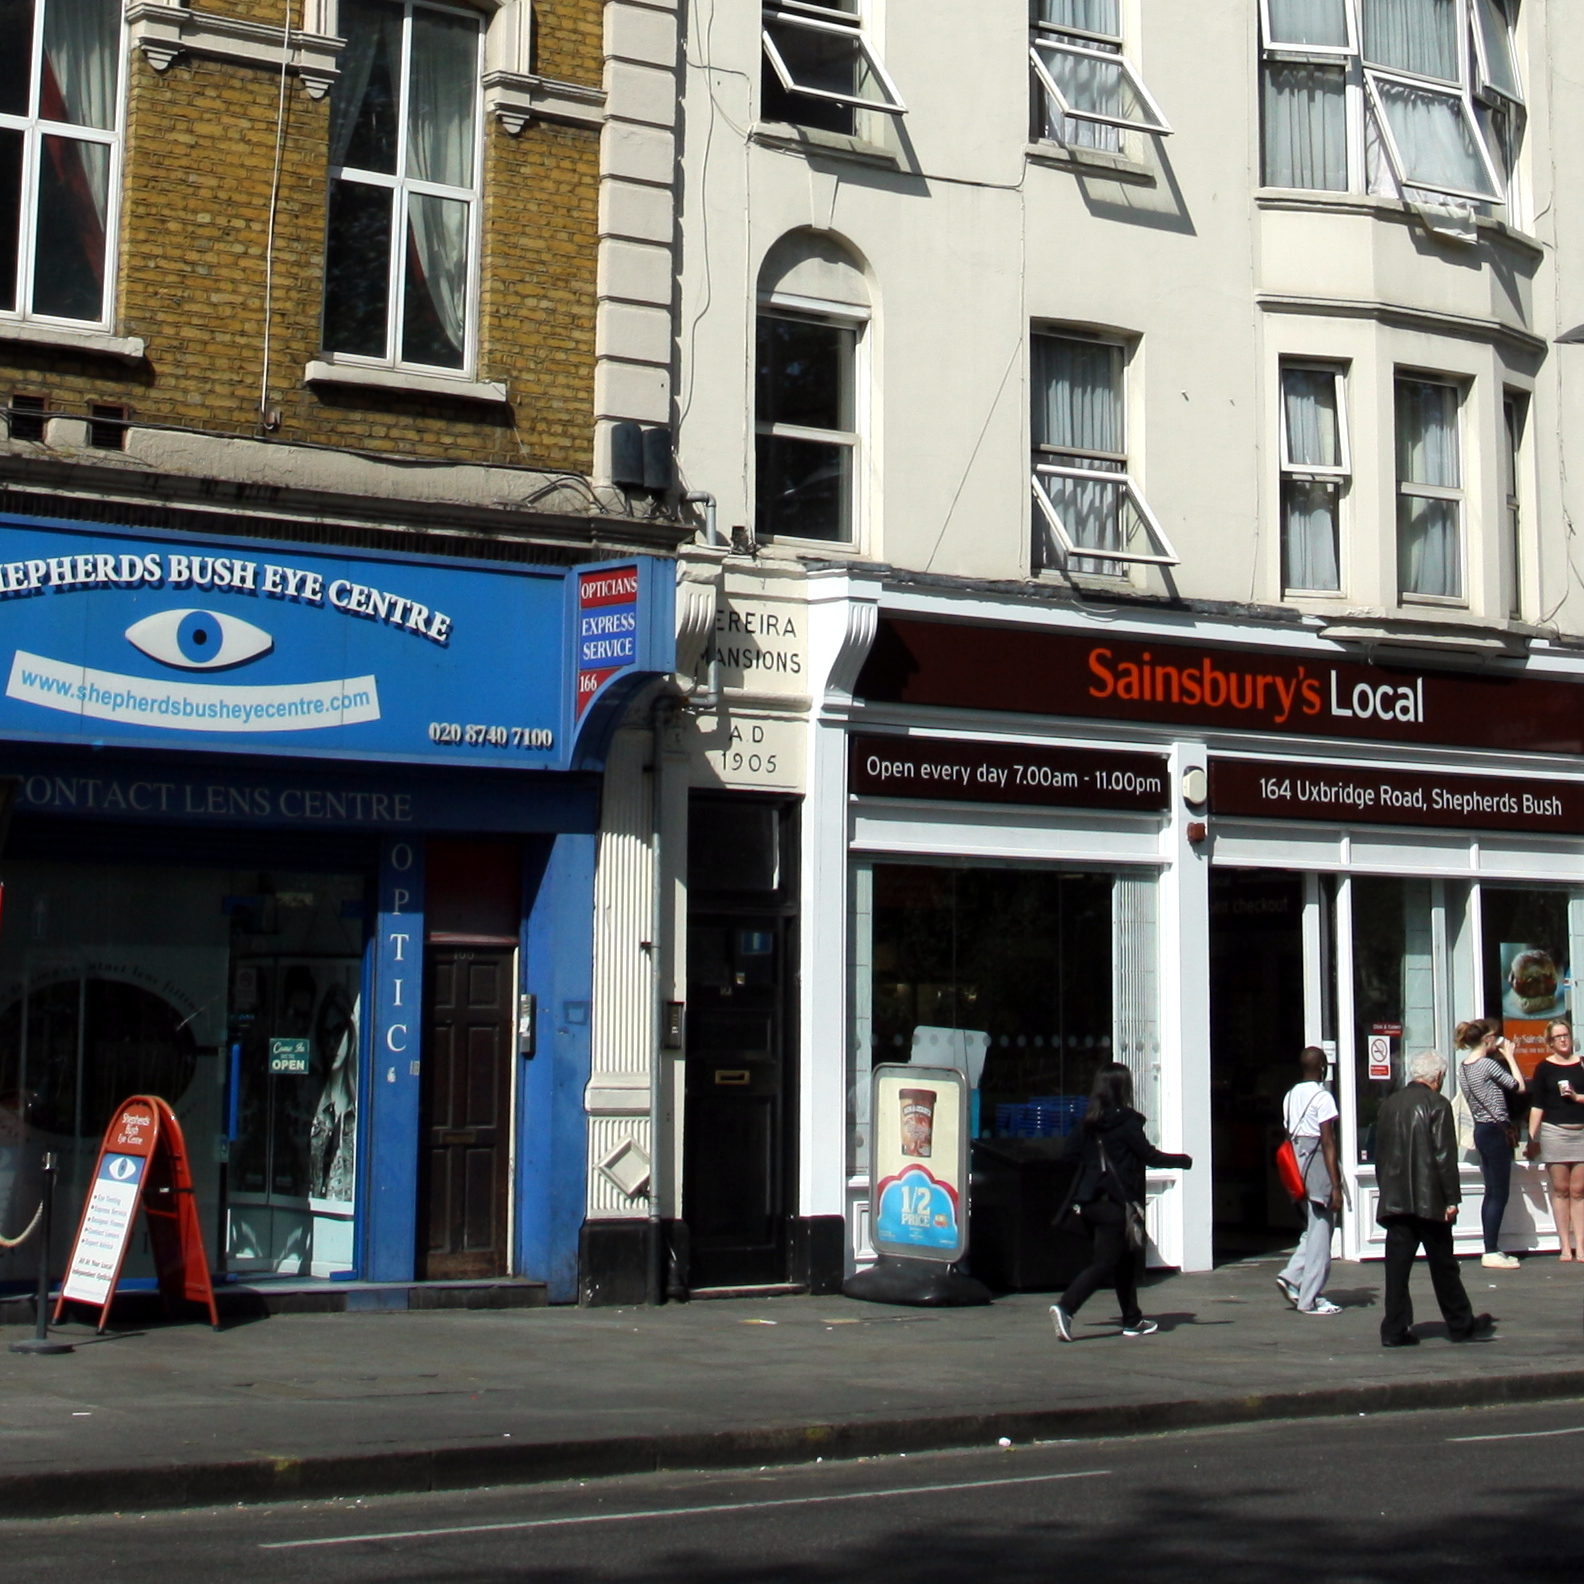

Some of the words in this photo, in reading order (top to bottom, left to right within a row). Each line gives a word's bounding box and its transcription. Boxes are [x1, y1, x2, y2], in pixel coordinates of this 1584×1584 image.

[168, 554, 255, 590] BUSH
[264, 566, 323, 602] EYE
[327, 578, 452, 643] CENTRE
[580, 575, 638, 599] OPTICIANS
[581, 612, 635, 637] EXPRESS
[716, 608, 798, 641] EREIRA
[582, 636, 635, 661] SERVICE
[20, 668, 372, 723] www.shepherdsbusheyecentre.com
[578, 673, 598, 694] 166
[1088, 647, 1322, 725] Sainsbury's
[1329, 668, 1425, 724] Local
[428, 721, 463, 745] 020
[465, 722, 509, 748] 8740
[511, 725, 554, 749] 7100
[720, 749, 778, 775] 1905
[866, 754, 915, 783] Open
[920, 760, 972, 788] every
[976, 762, 1009, 789] day
[1012, 764, 1079, 790] 7.00am
[1094, 769, 1163, 798] 11.00pm
[184, 784, 272, 816] LENS
[278, 786, 414, 822] CENTRE
[1259, 776, 1293, 801] 164
[1297, 779, 1375, 813] Uxbridge
[1379, 783, 1428, 814] Road,
[1431, 788, 1517, 818] Shepherds
[1521, 792, 1563, 818] Bush
[271, 1059, 306, 1071] OPEN
[901, 1184, 932, 1214] 1/2
[901, 1213, 931, 1228] PRICE
